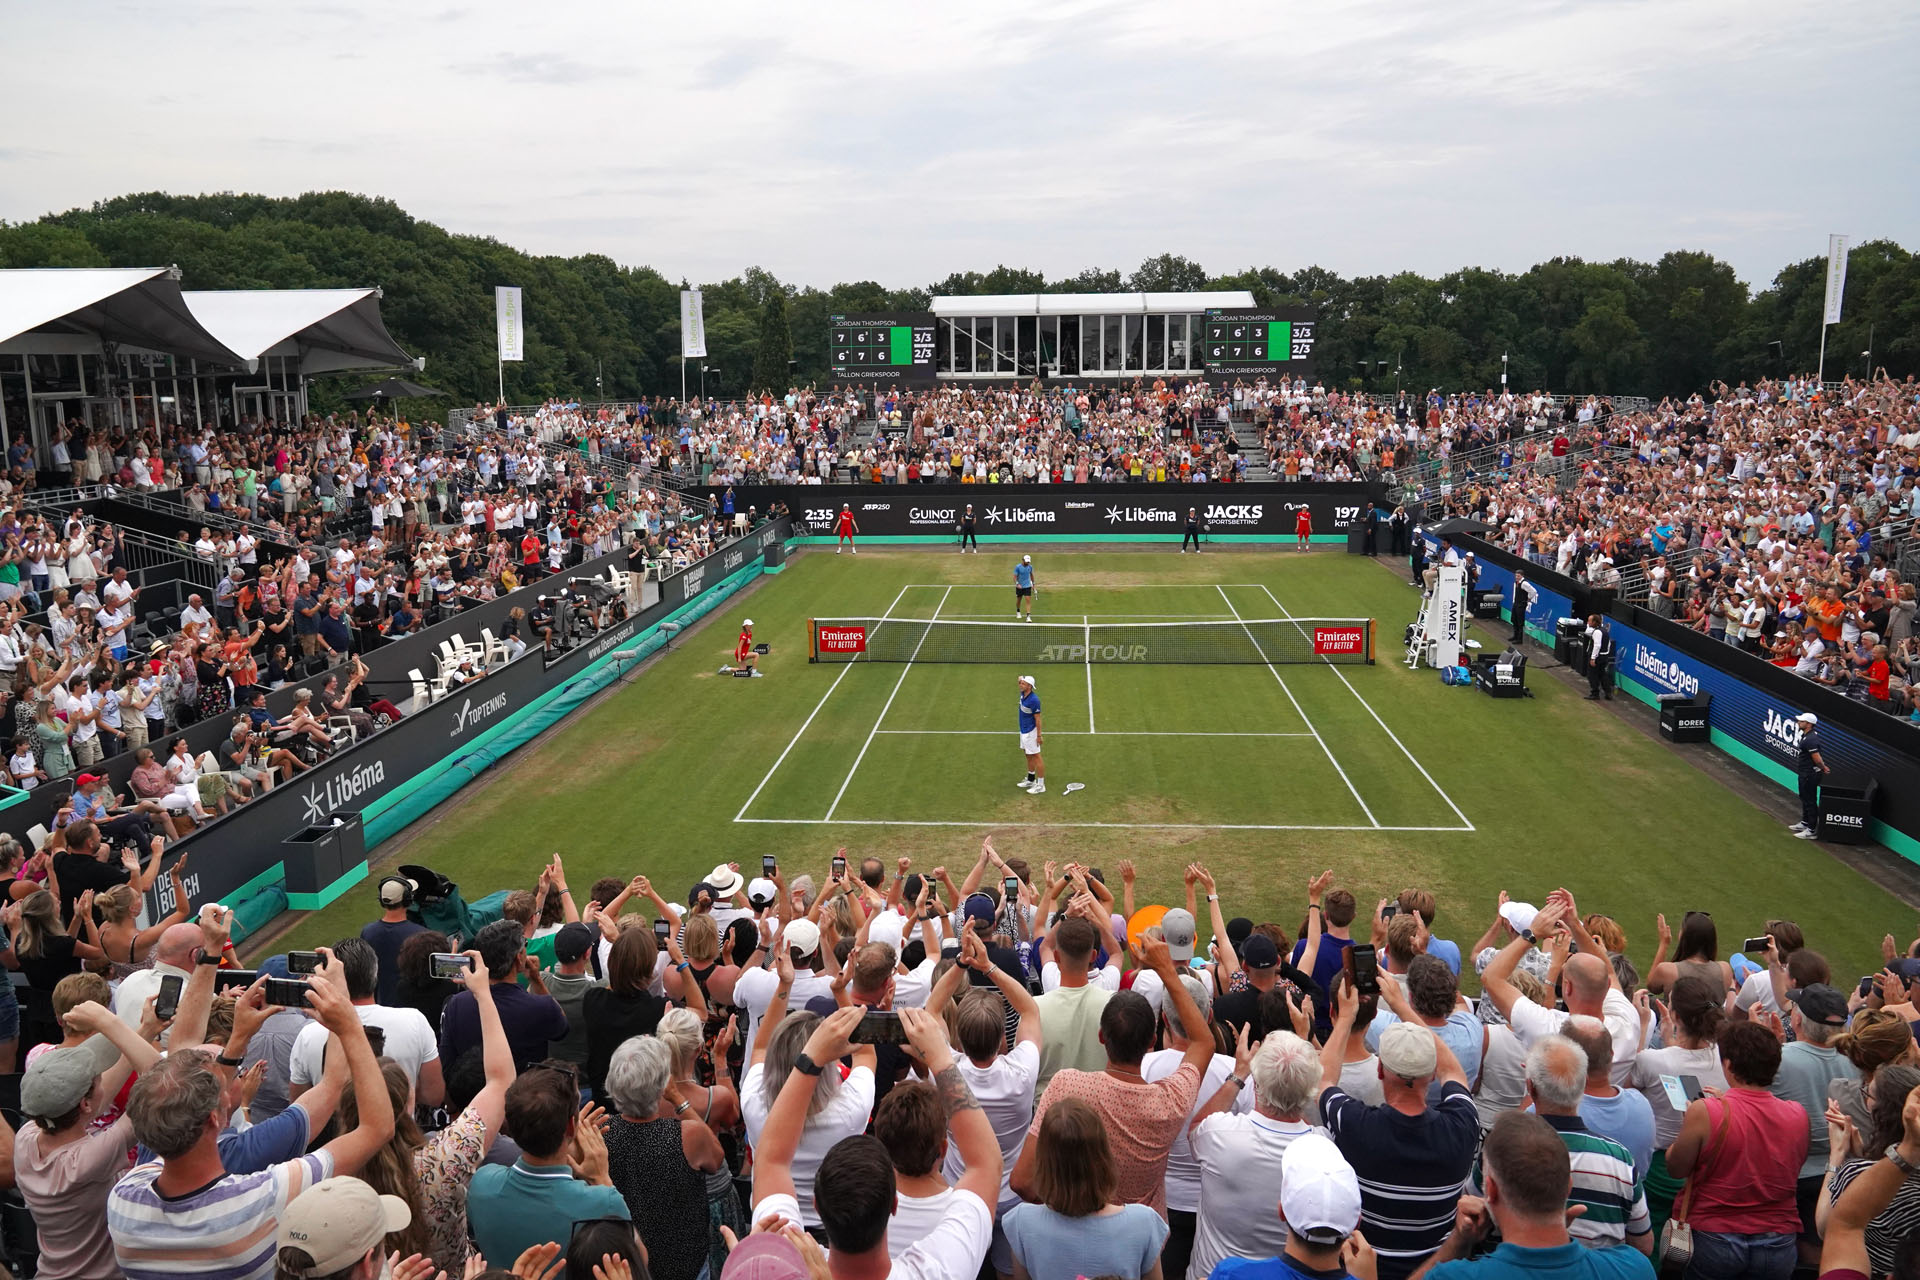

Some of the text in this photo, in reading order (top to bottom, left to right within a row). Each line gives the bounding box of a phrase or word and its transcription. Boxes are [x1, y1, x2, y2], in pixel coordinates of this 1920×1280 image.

[838, 334, 845, 342] 7
[878, 334, 885, 342] 3
[914, 332, 932, 343] 3/3
[1213, 329, 1221, 338] 7
[1255, 328, 1262, 337] 3
[1293, 327, 1311, 338] 3/3
[914, 348, 932, 359] 2/3
[1233, 348, 1241, 356] 7
[1254, 347, 1262, 356] 6
[1292, 343, 1311, 354] 2/3
[858, 352, 865, 360] 7
[878, 352, 885, 360] 6
[804, 509, 834, 521] 2:35
[908, 507, 956, 520] GUINOT
[1004, 508, 1056, 522] Libéma
[1125, 507, 1177, 522] Libéma
[1203, 504, 1263, 519] JACKS
[1334, 507, 1360, 518] 197
[808, 521, 831, 529] TIME
[1440, 600, 1448, 641] LOGISTICS
[1447, 600, 1458, 641] AMEX
[821, 631, 864, 641] Emirates
[1317, 632, 1361, 641] Emirates
[827, 641, 858, 649] FLY BETTER
[1323, 641, 1354, 650] FLY BETTER
[1034, 644, 1148, 660] ATP TOUR
[1634, 643, 1699, 696] Libéma Open
[467, 691, 507, 727] TOPTENNIS
[1763, 708, 1806, 747] JACK
[1765, 734, 1800, 758] SPORTSBET
[326, 760, 385, 812] Libéma
[1825, 813, 1864, 825] BOREK
[160, 872, 201, 915] BOCH
[289, 1230, 308, 1241] POLO
